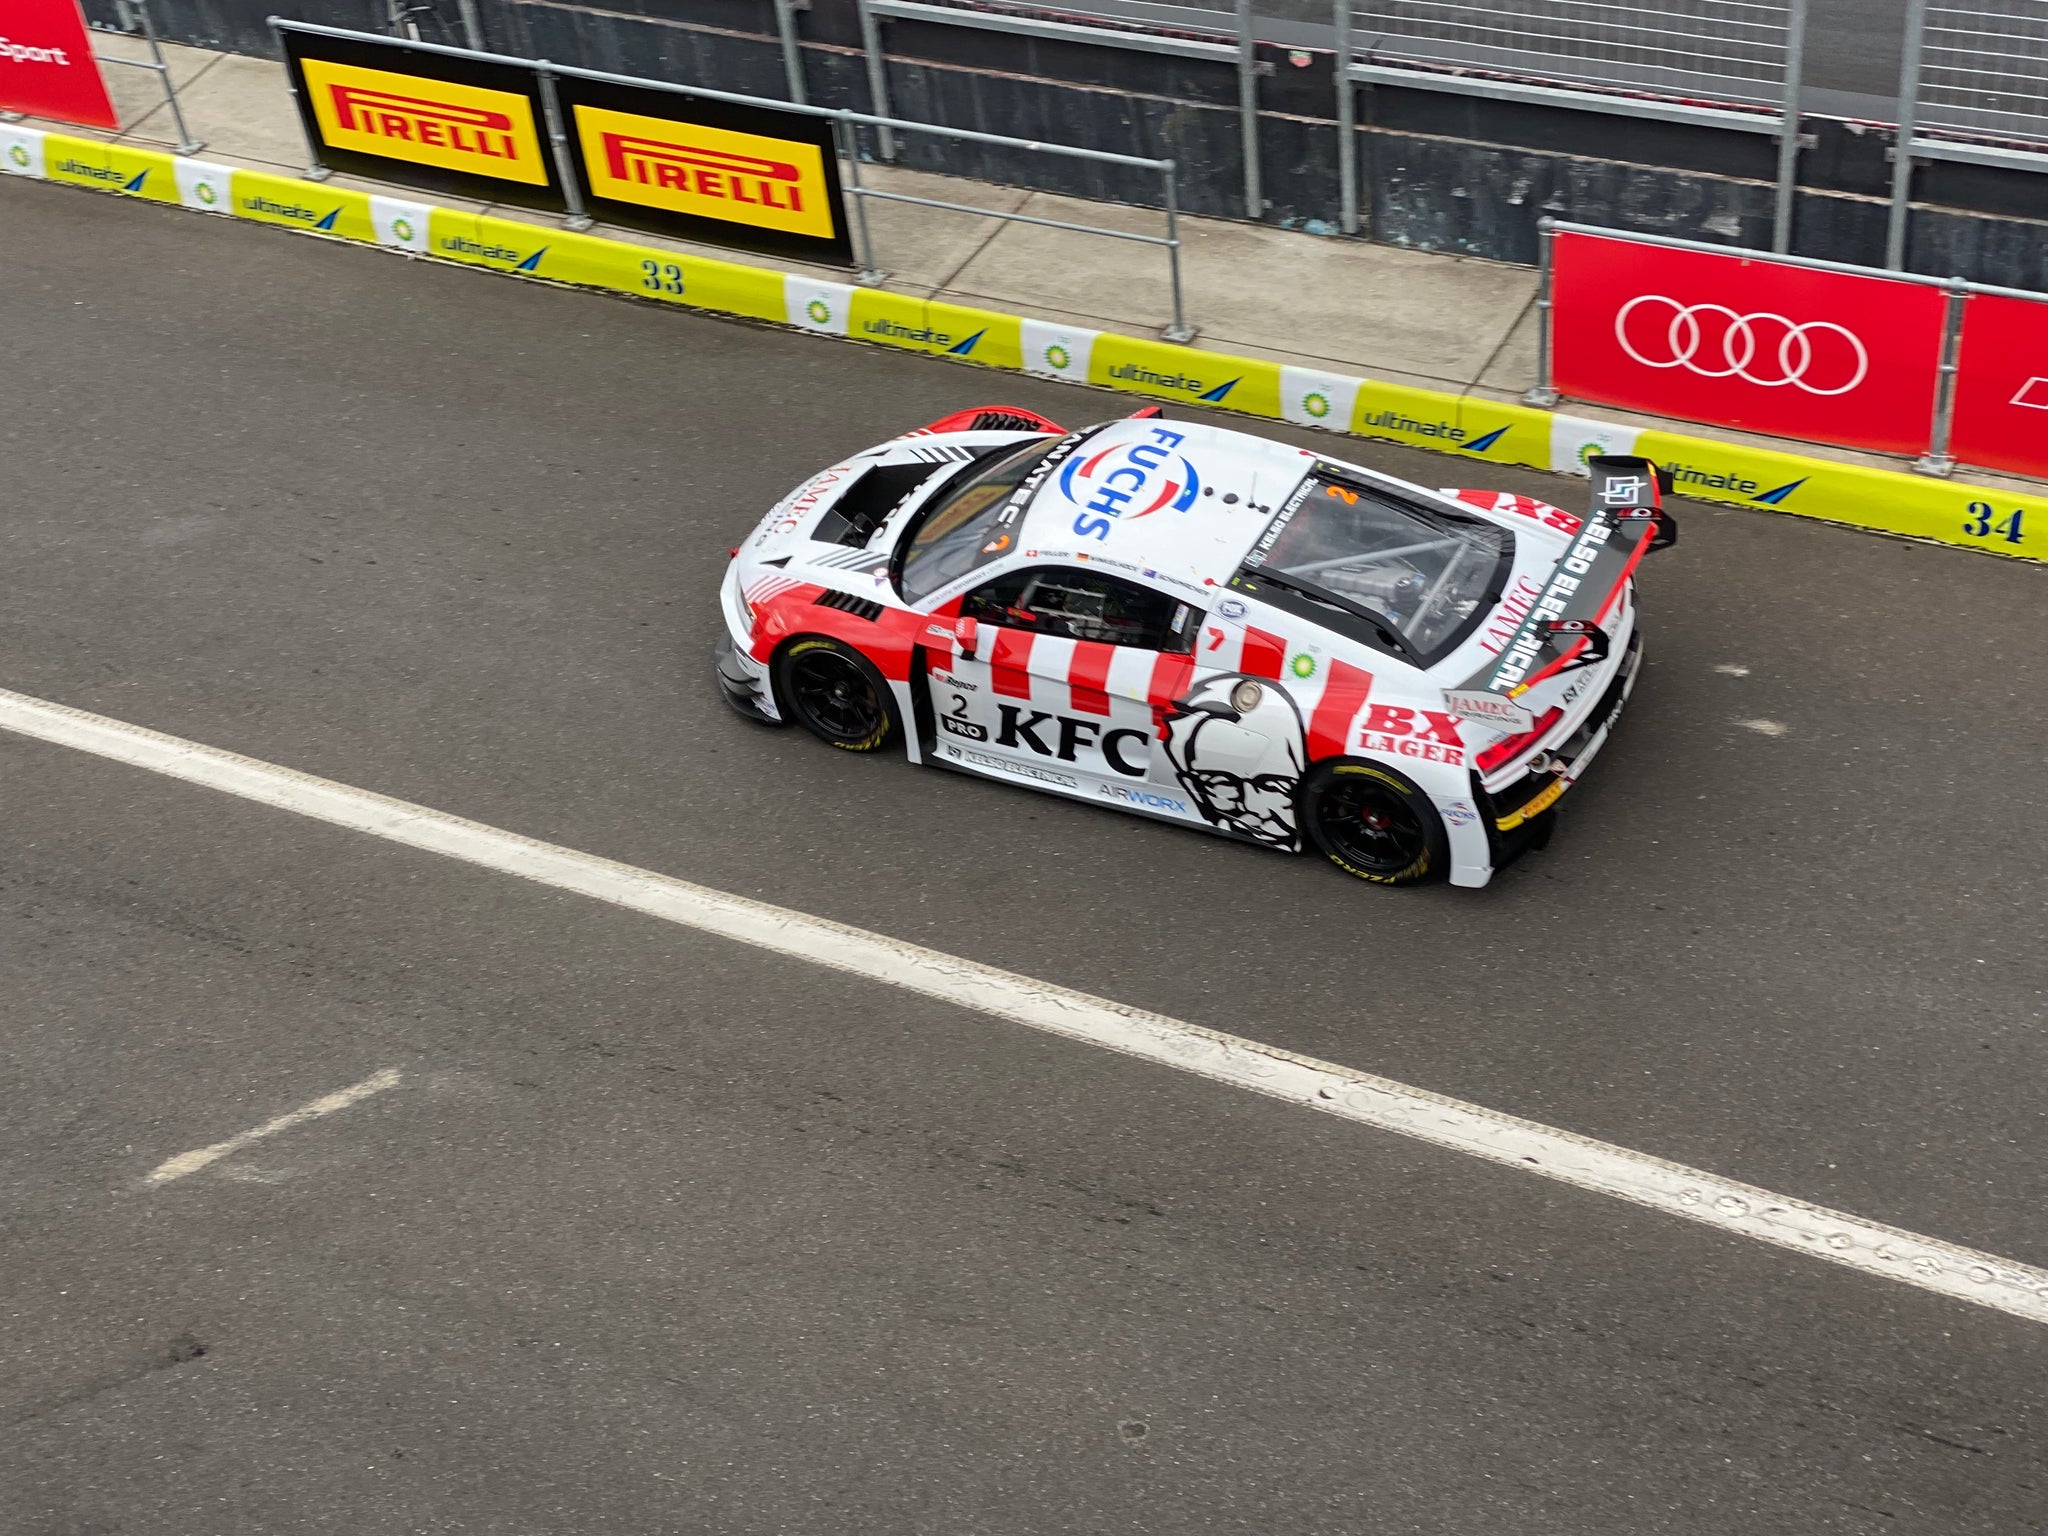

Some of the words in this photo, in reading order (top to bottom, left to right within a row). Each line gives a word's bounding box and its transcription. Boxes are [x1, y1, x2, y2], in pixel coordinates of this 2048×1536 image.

[0, 36, 71, 66] Sport
[327, 84, 517, 160] PIRELLI
[55, 157, 125, 185] ultimate
[601, 132, 804, 212] PIRELLI
[242, 196, 316, 222] ultimate
[441, 235, 519, 264] ultimate
[641, 260, 685, 296] 33
[863, 318, 951, 348] ultimate
[1108, 363, 1203, 393] ultimate
[1364, 410, 1467, 444] ultimate
[1073, 427, 1186, 541] FUCHS
[1326, 485, 1359, 505] 2
[1259, 520, 1287, 551] KELSO
[1963, 501, 2025, 544] 34
[1488, 572, 1582, 691] ELECRICAL
[952, 694, 968, 719] 2
[946, 718, 982, 738] PRO
[996, 702, 1151, 780] KFC
[1362, 703, 1465, 749] BX
[1358, 732, 1464, 767] LAGER
[1099, 783, 1188, 813] AIRWORX
